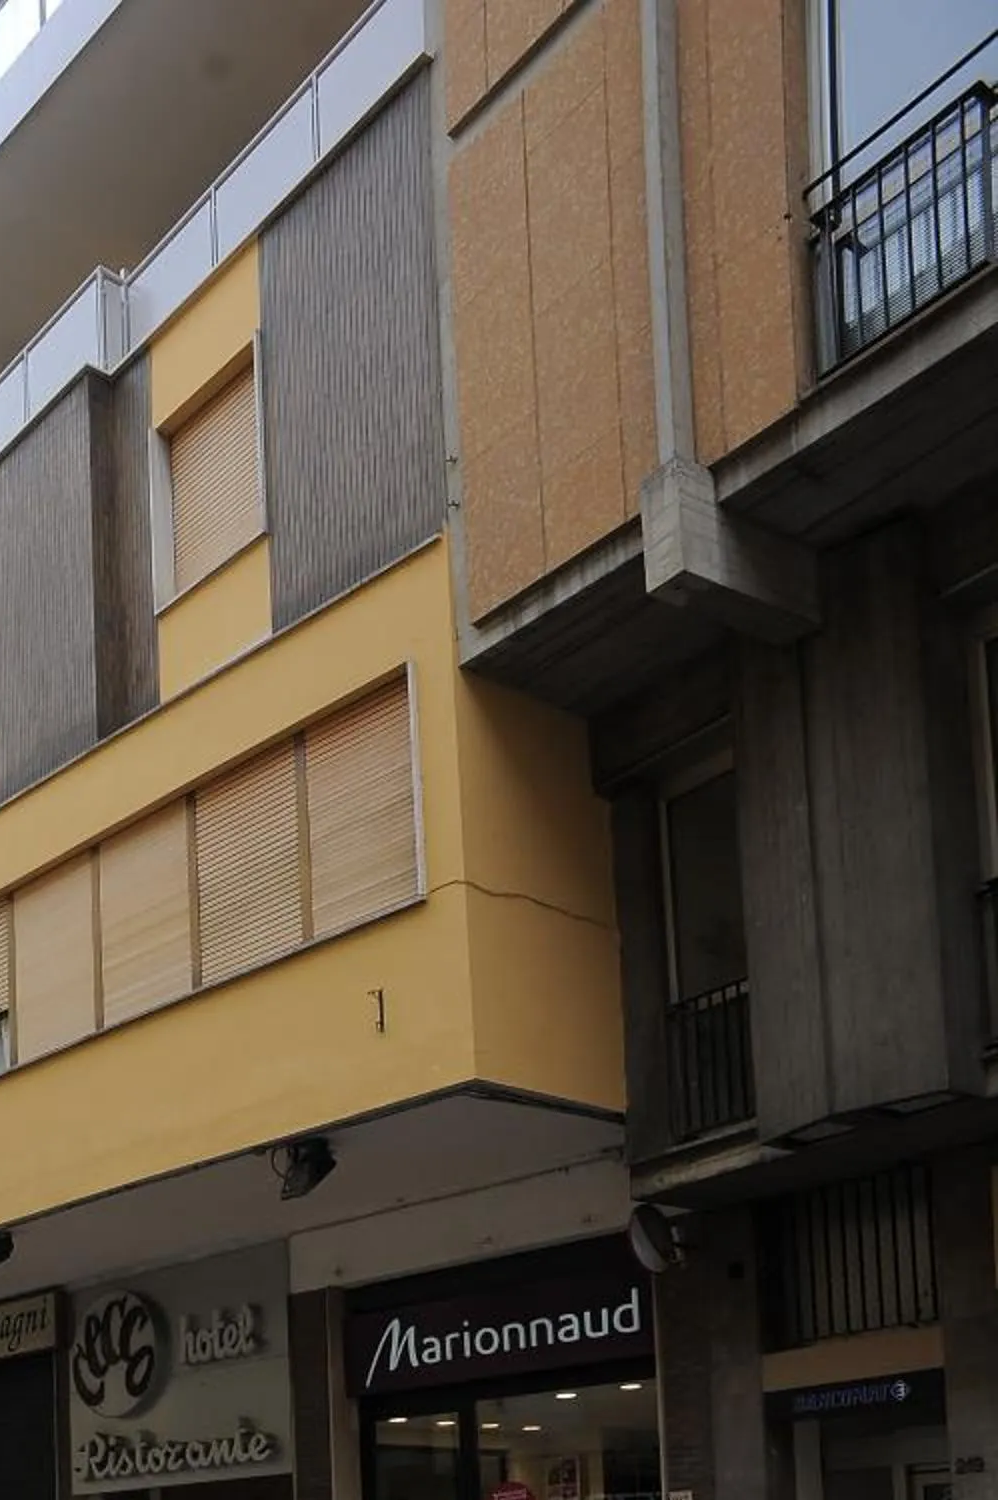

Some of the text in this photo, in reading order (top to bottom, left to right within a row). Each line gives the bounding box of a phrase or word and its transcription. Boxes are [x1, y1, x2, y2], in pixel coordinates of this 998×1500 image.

[180, 1304, 255, 1364] hotel
[365, 1286, 643, 1389] Marionnaud
[77, 1429, 272, 1481] Ristorante
